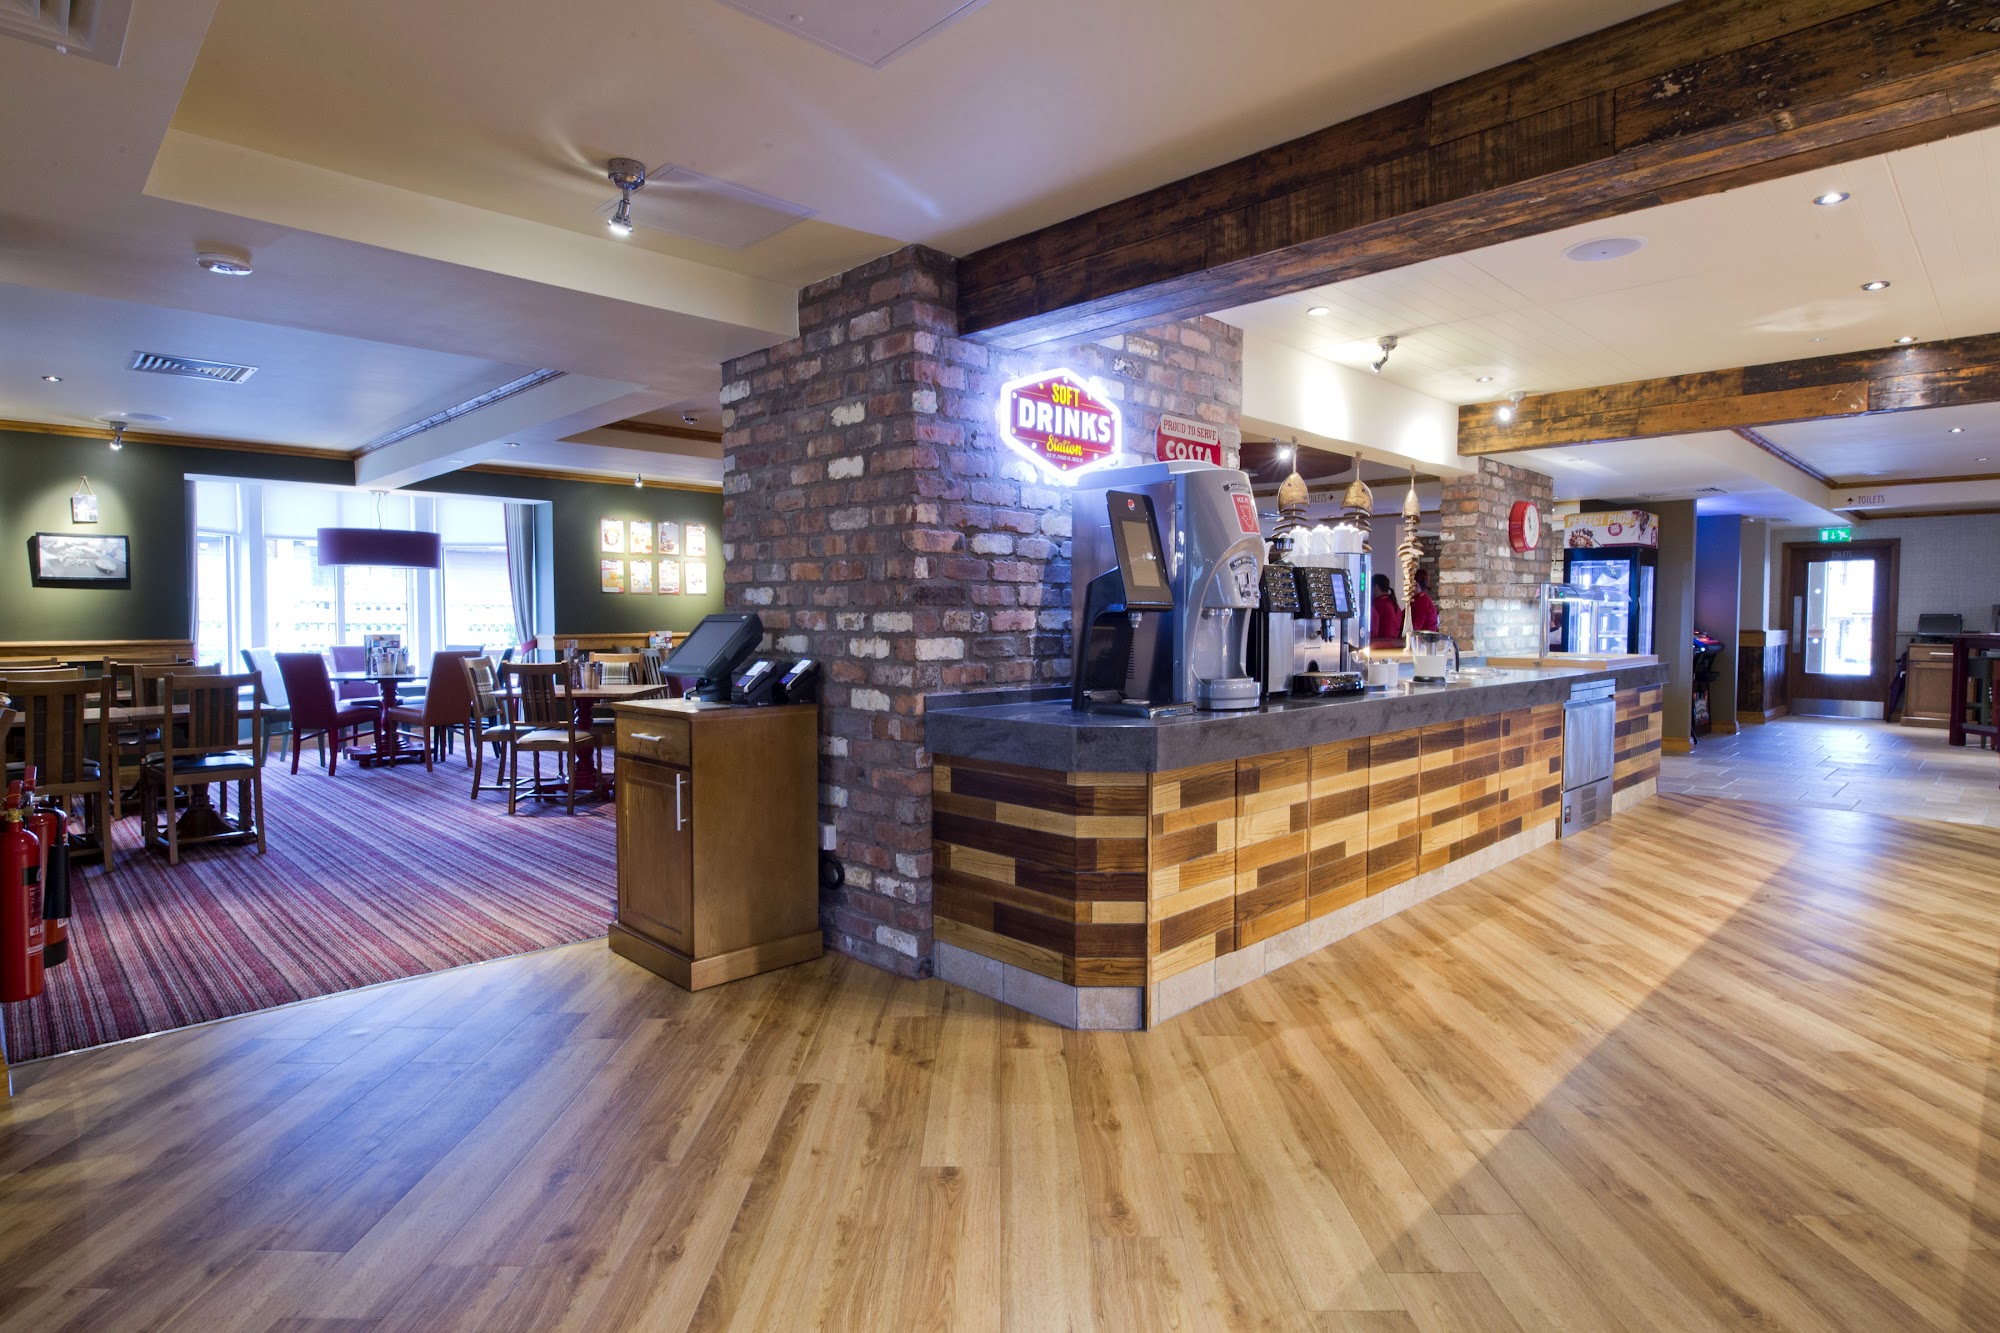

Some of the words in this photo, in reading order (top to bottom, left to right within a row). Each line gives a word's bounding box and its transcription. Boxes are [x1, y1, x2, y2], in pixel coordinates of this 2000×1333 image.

[1052, 383, 1080, 407] SOFT
[1018, 396, 1111, 444] DRINKS
[1163, 419, 1186, 434] PROUD
[1187, 425, 1196, 436] TO
[1196, 427, 1217, 441] SERVE
[1046, 434, 1083, 456] Station
[1165, 440, 1213, 464] COSTA
[1308, 493, 1327, 503] OILETS
[1857, 495, 1885, 504] TOILETS
[1567, 514, 1605, 527] PERFECT
[1607, 512, 1631, 524] PUDS
